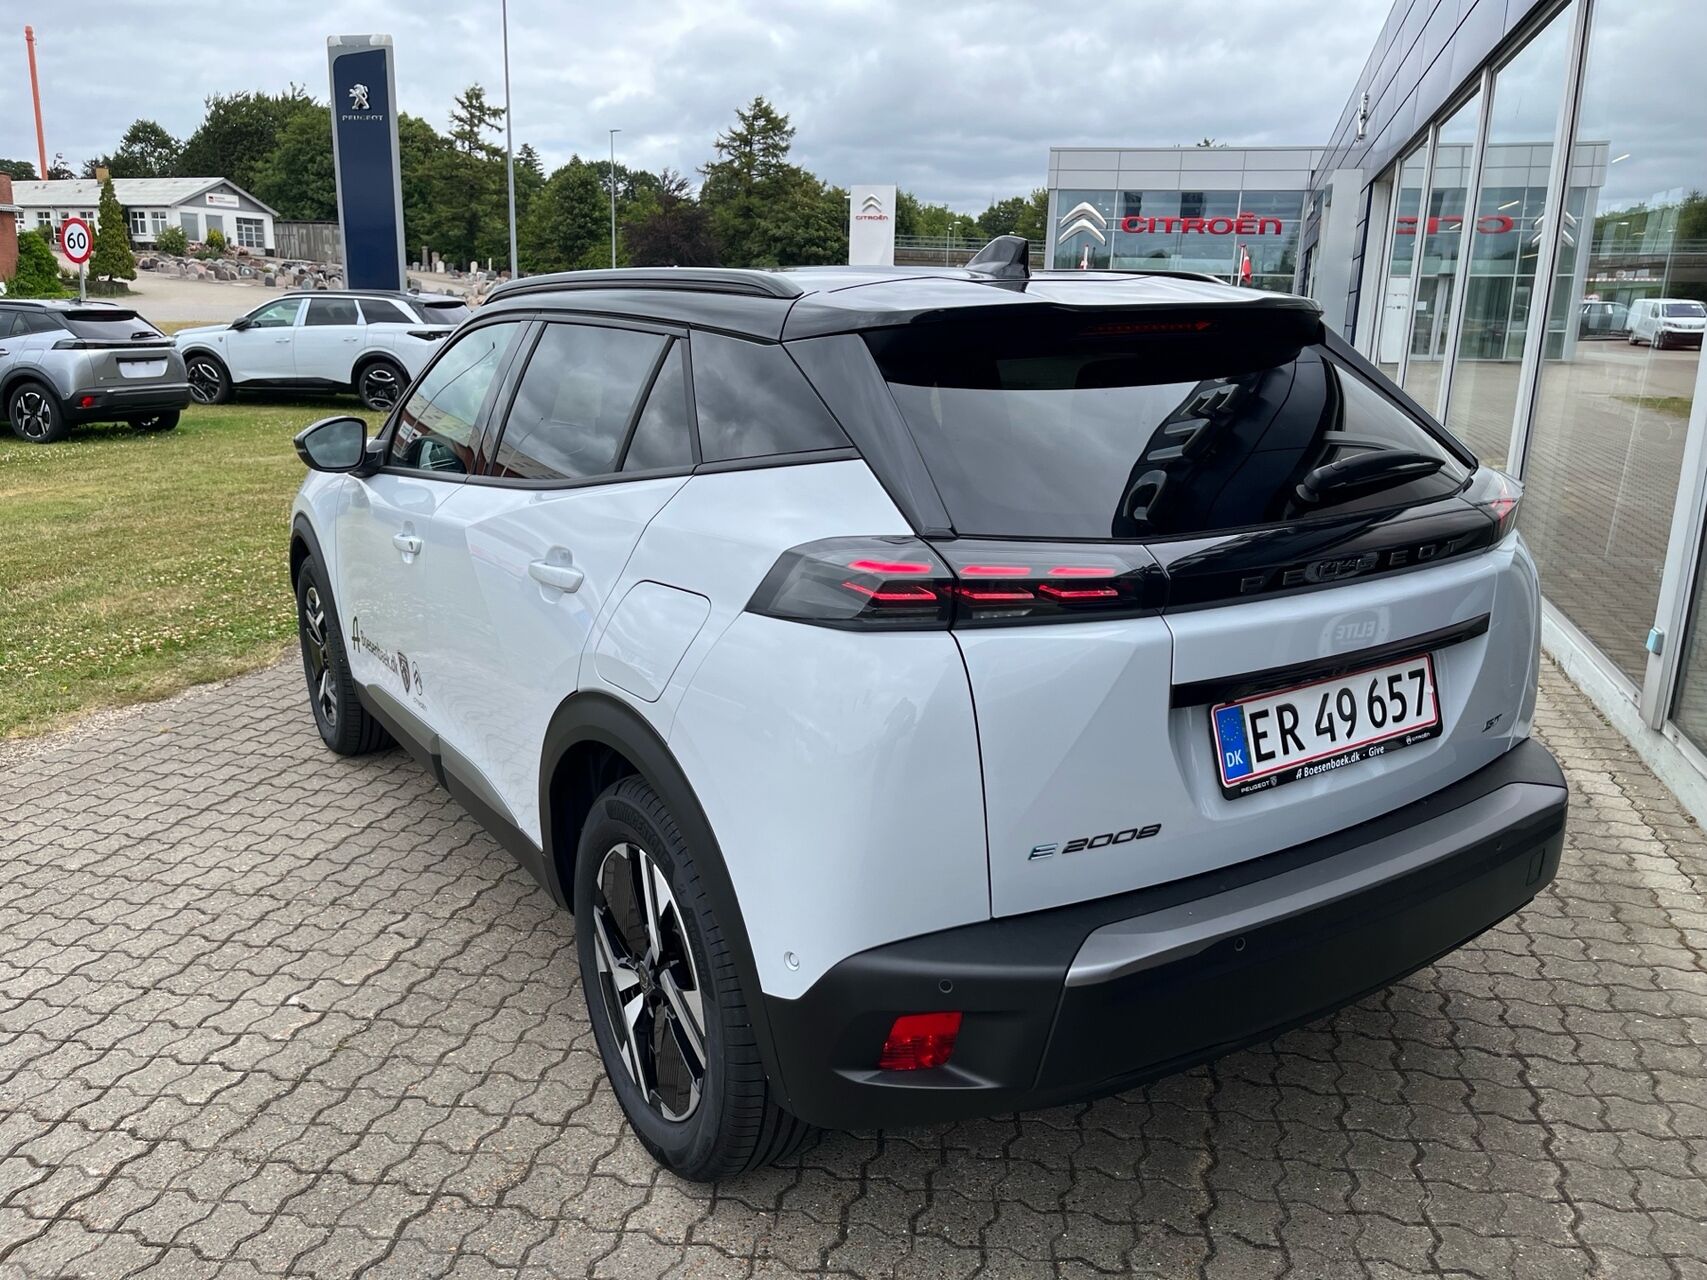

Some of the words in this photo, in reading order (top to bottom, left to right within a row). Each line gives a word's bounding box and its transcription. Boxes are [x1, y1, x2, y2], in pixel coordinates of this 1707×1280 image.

[1121, 211, 1282, 235] CITROËN
[67, 232, 87, 249] 60
[1249, 702, 1306, 763] ER
[1315, 687, 1358, 742] 49
[1367, 668, 1426, 729] 657
[1226, 749, 1244, 768] DK
[1368, 745, 1385, 757] Give
[1240, 780, 1270, 793] PEUGEOT
[1061, 823, 1162, 854] 2008
